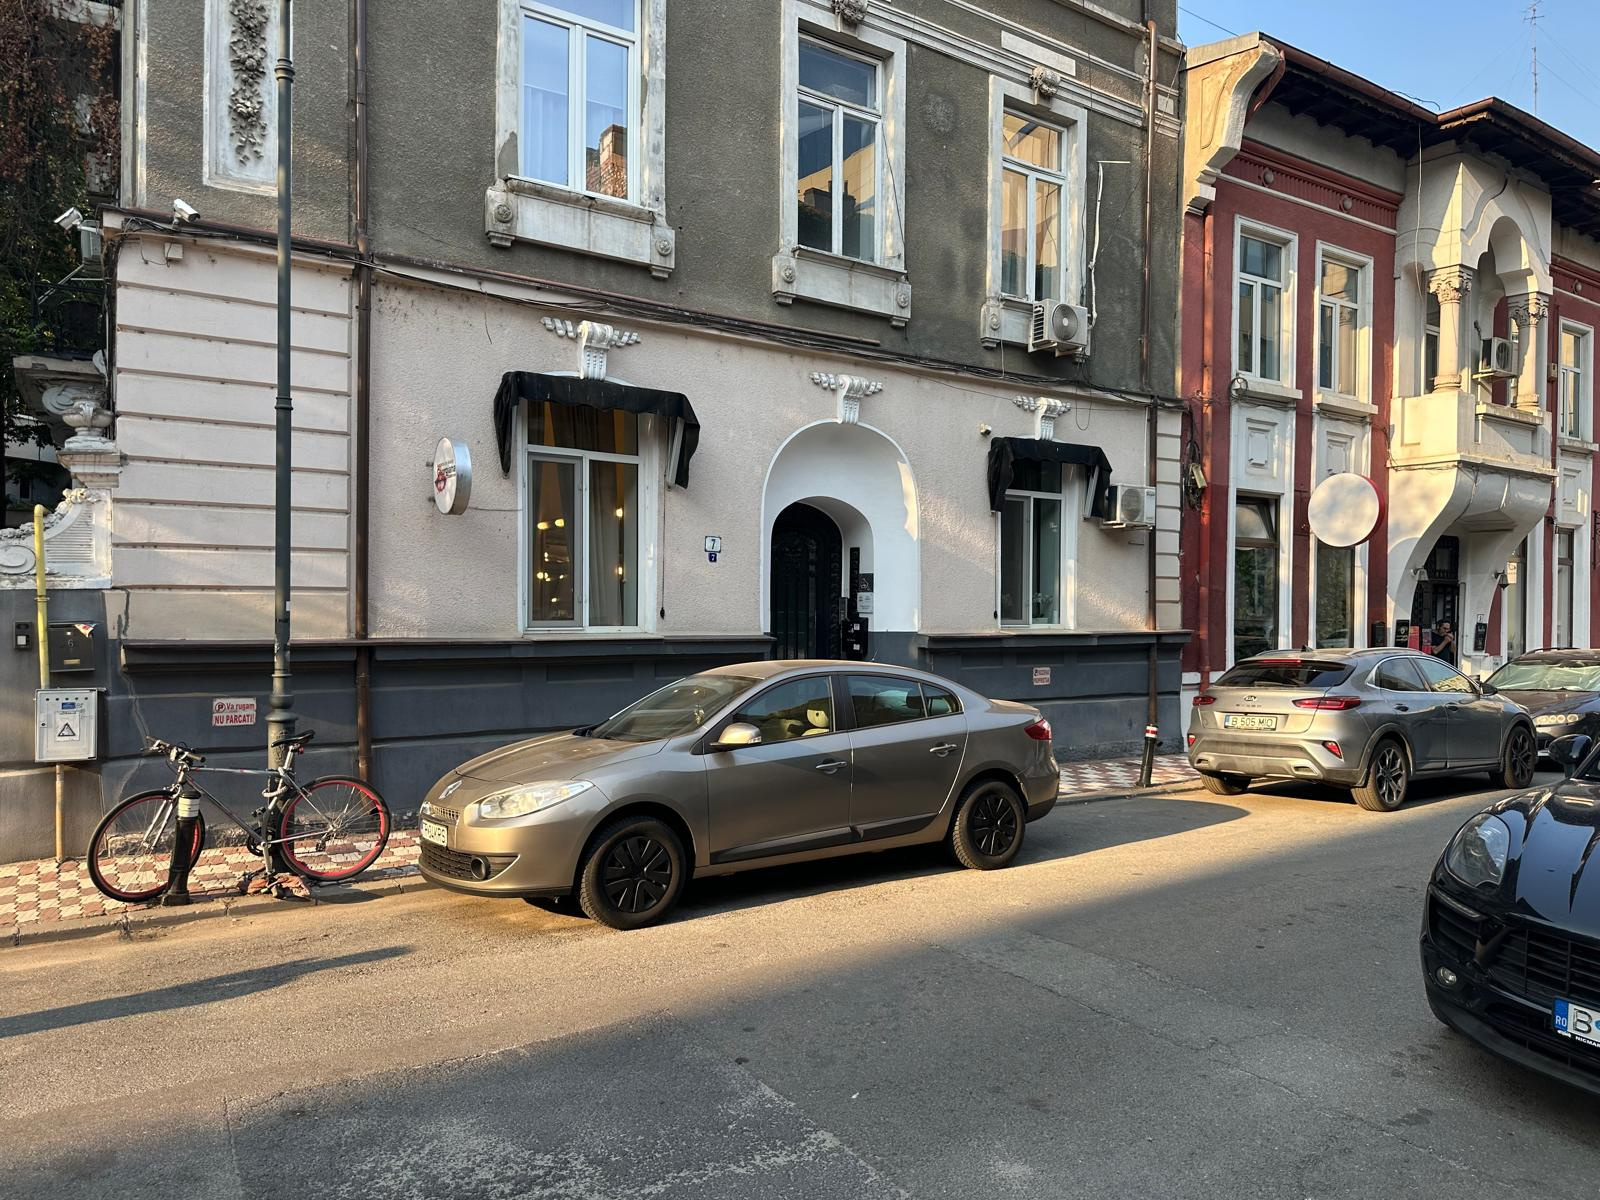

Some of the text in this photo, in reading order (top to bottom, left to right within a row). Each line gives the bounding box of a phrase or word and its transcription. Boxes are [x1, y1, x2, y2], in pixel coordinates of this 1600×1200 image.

[711, 538, 716, 550] 7
[67, 639, 74, 649] 6
[215, 715, 224, 724] NU
[1555, 1015, 1567, 1027] RO
[1573, 1008, 1593, 1034] B
